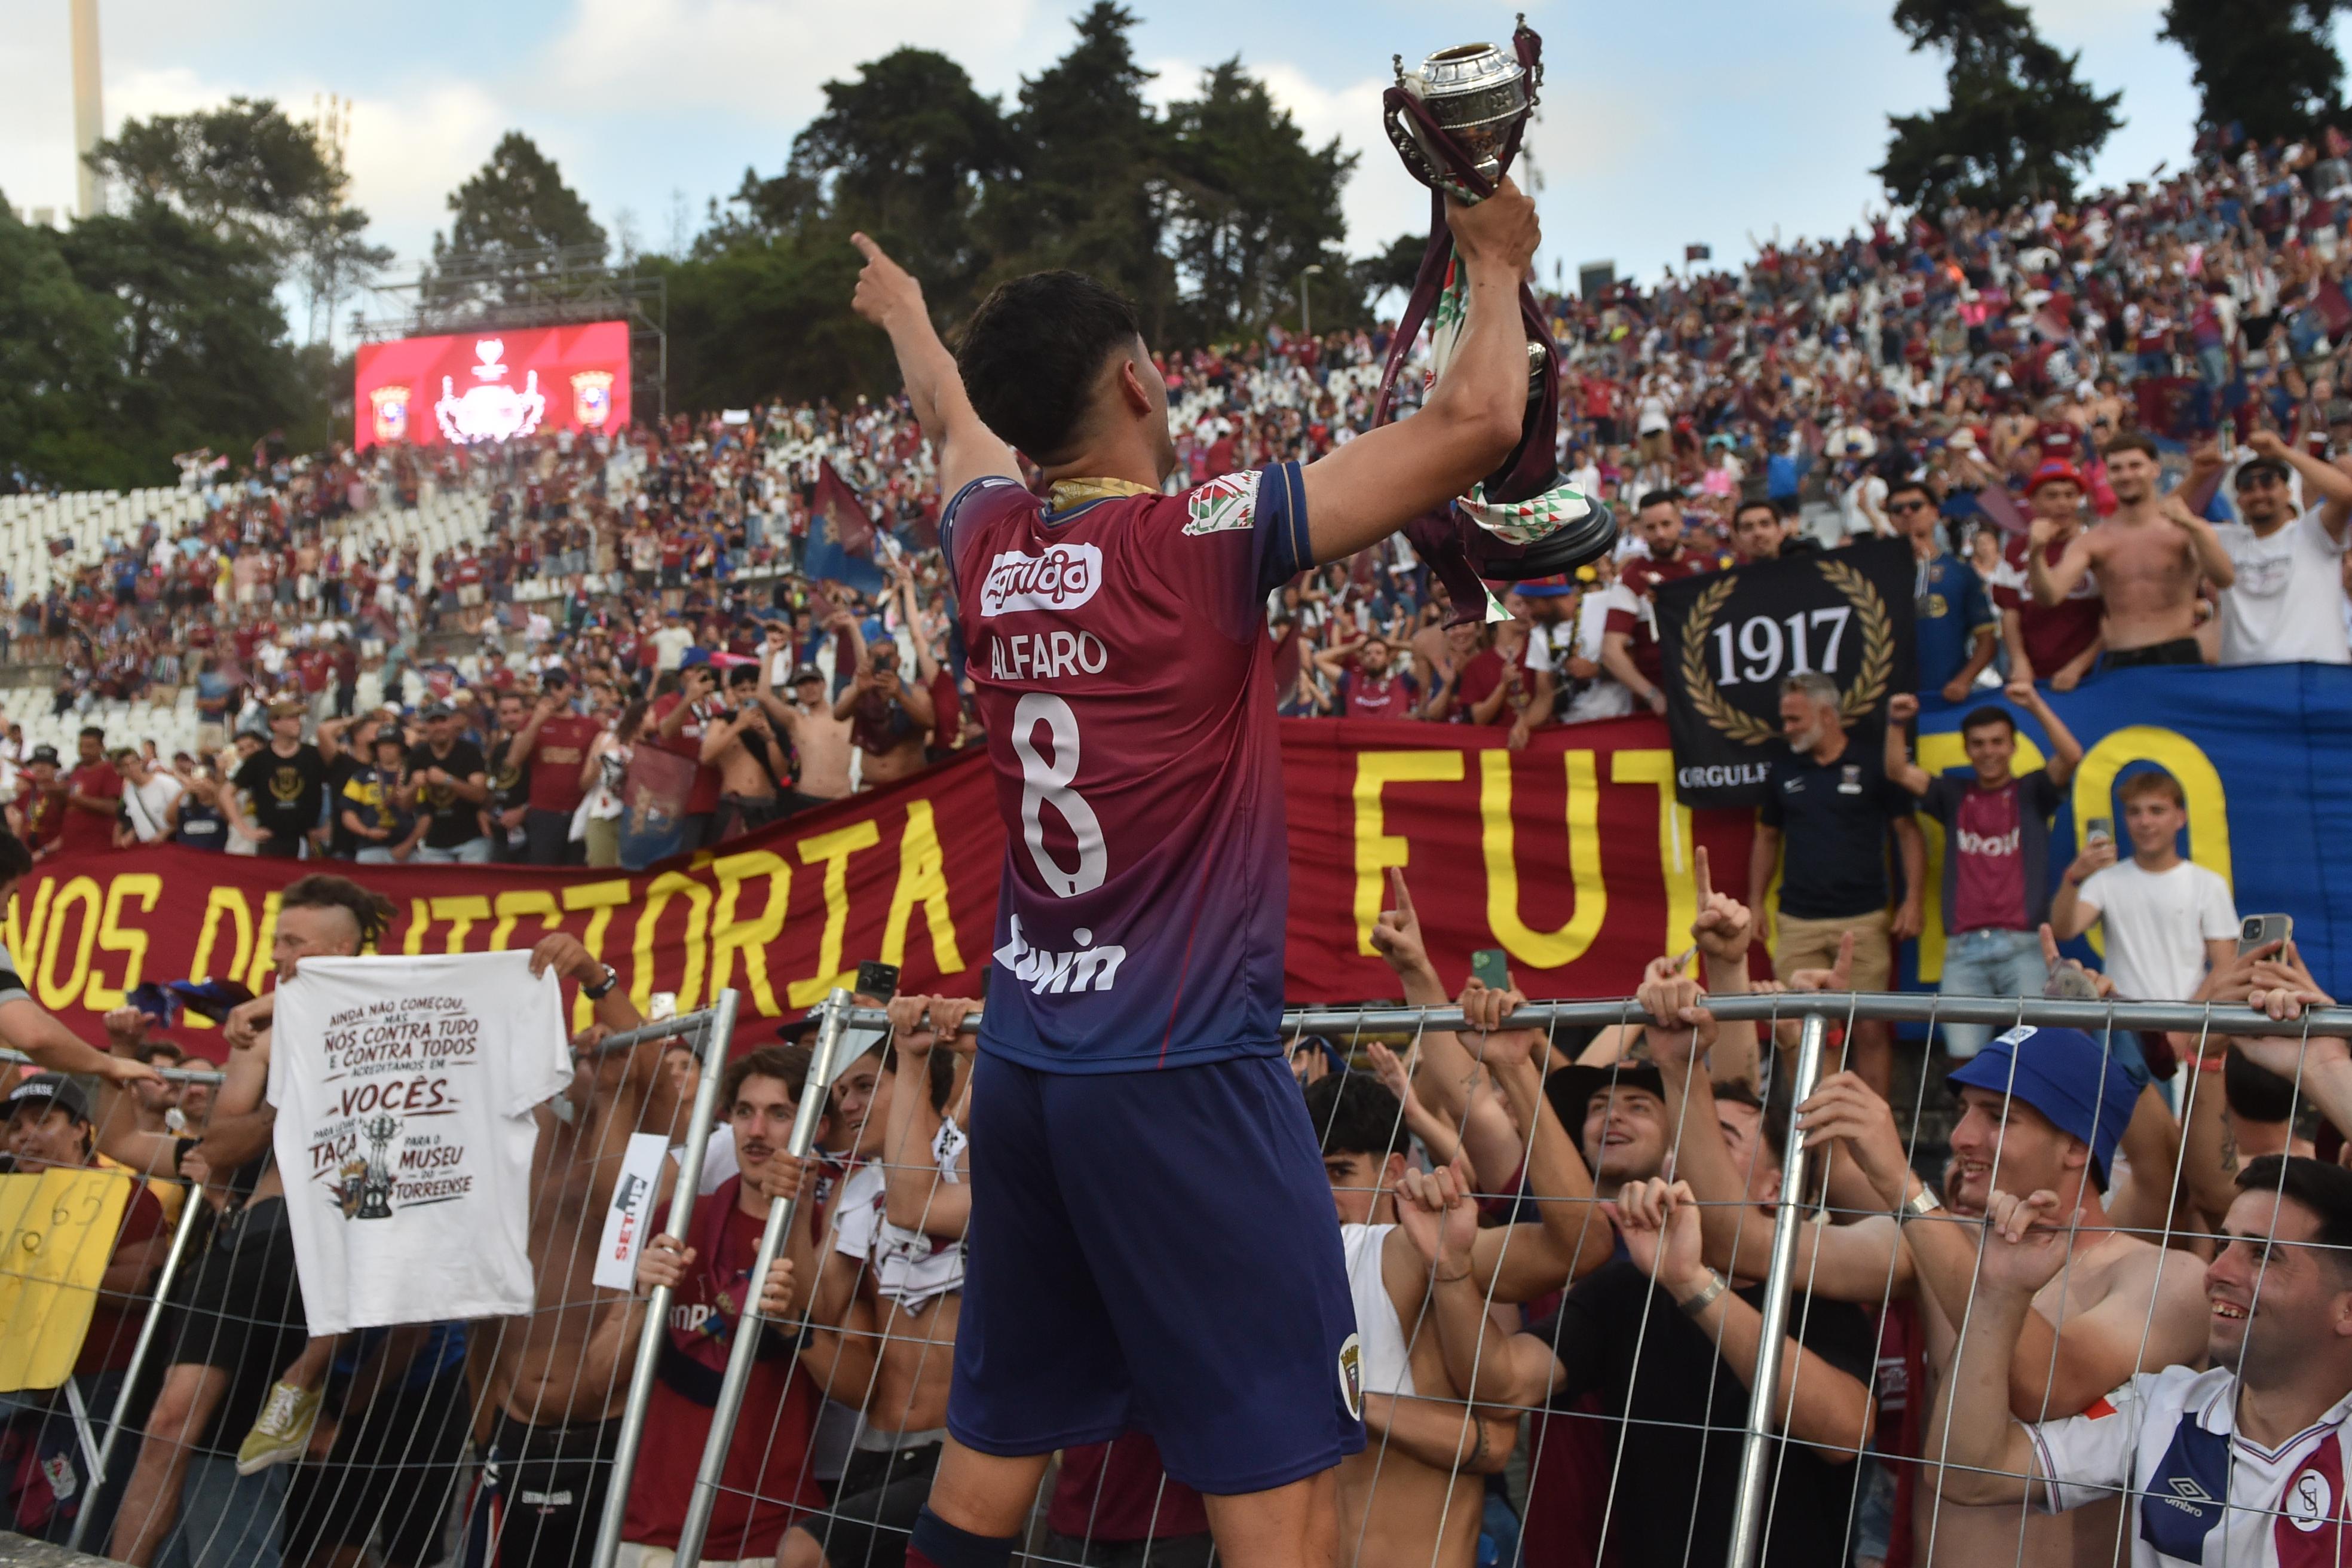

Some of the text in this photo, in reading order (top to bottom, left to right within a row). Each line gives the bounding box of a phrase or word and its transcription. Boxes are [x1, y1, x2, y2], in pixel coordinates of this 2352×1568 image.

[991, 630, 1107, 680] ALFARO
[1713, 606, 1851, 686] 1917
[1012, 693, 1107, 898] 8
[360, 799, 966, 1035] TÓRIA
[330, 1008, 364, 1027] AINDA
[369, 999, 394, 1016] NÃO
[383, 1013, 408, 1024] MAS
[324, 1019, 478, 1053] NÓS CONTRA TUDO
[329, 1037, 477, 1070] E CONTRA TODOS
[429, 1058, 445, 1070] EM
[342, 1075, 448, 1116] VOCÊS
[308, 1133, 357, 1168] TAÇA
[399, 1146, 464, 1169] MUSEU
[395, 1175, 474, 1200] TORREENSE
[2164, 1497, 2203, 1518] umbro
